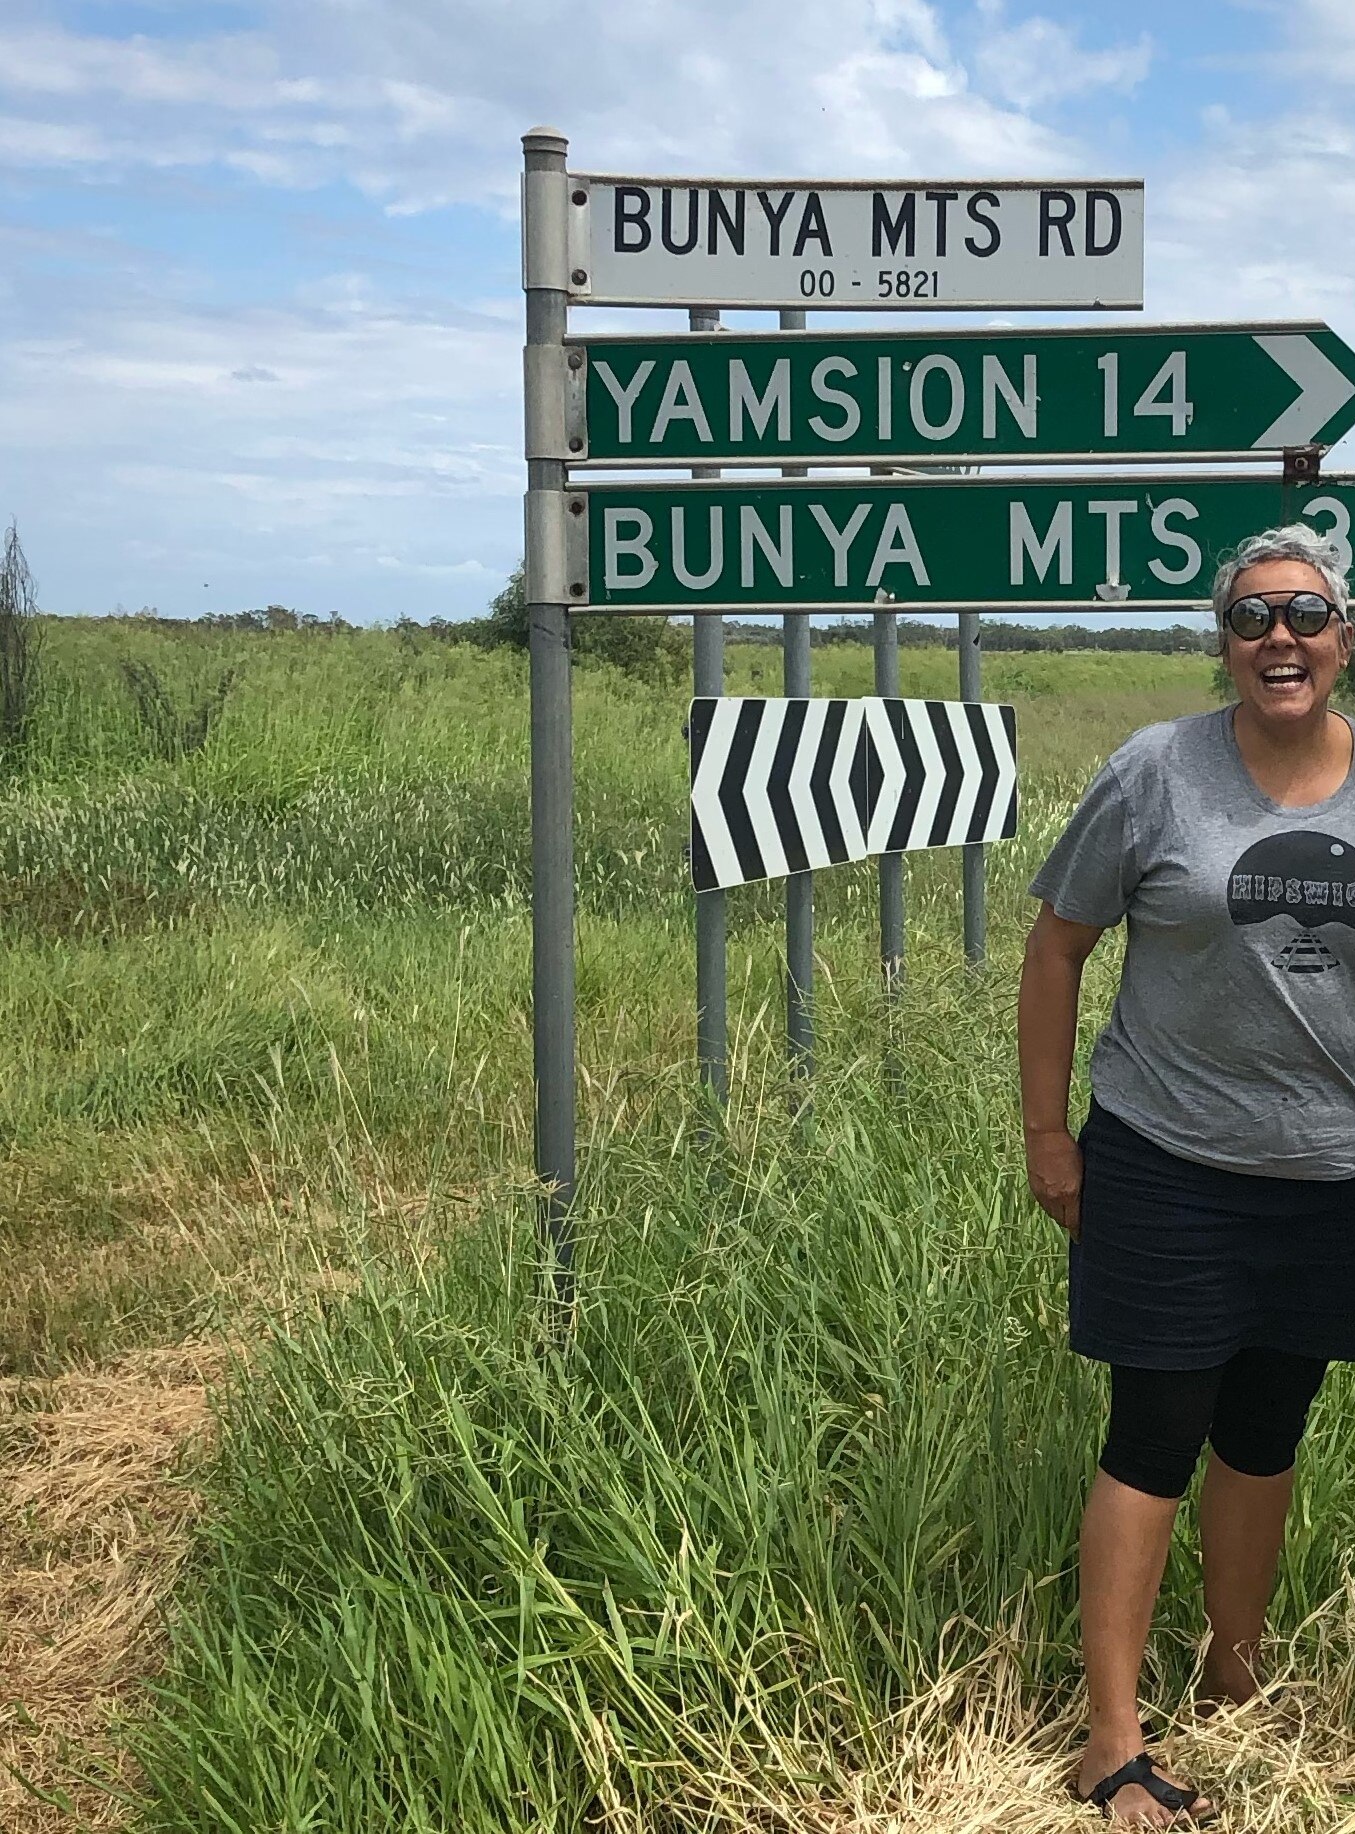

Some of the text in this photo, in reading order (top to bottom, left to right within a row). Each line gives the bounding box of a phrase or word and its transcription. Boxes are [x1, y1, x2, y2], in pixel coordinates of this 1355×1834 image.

[613, 186, 1123, 258] BUNYA MTS RD
[799, 269, 835, 298] 00
[878, 270, 938, 298] 5821
[592, 351, 1194, 443] YAMSION 14
[604, 503, 931, 590] BUNYA
[1009, 498, 1202, 586] MTS
